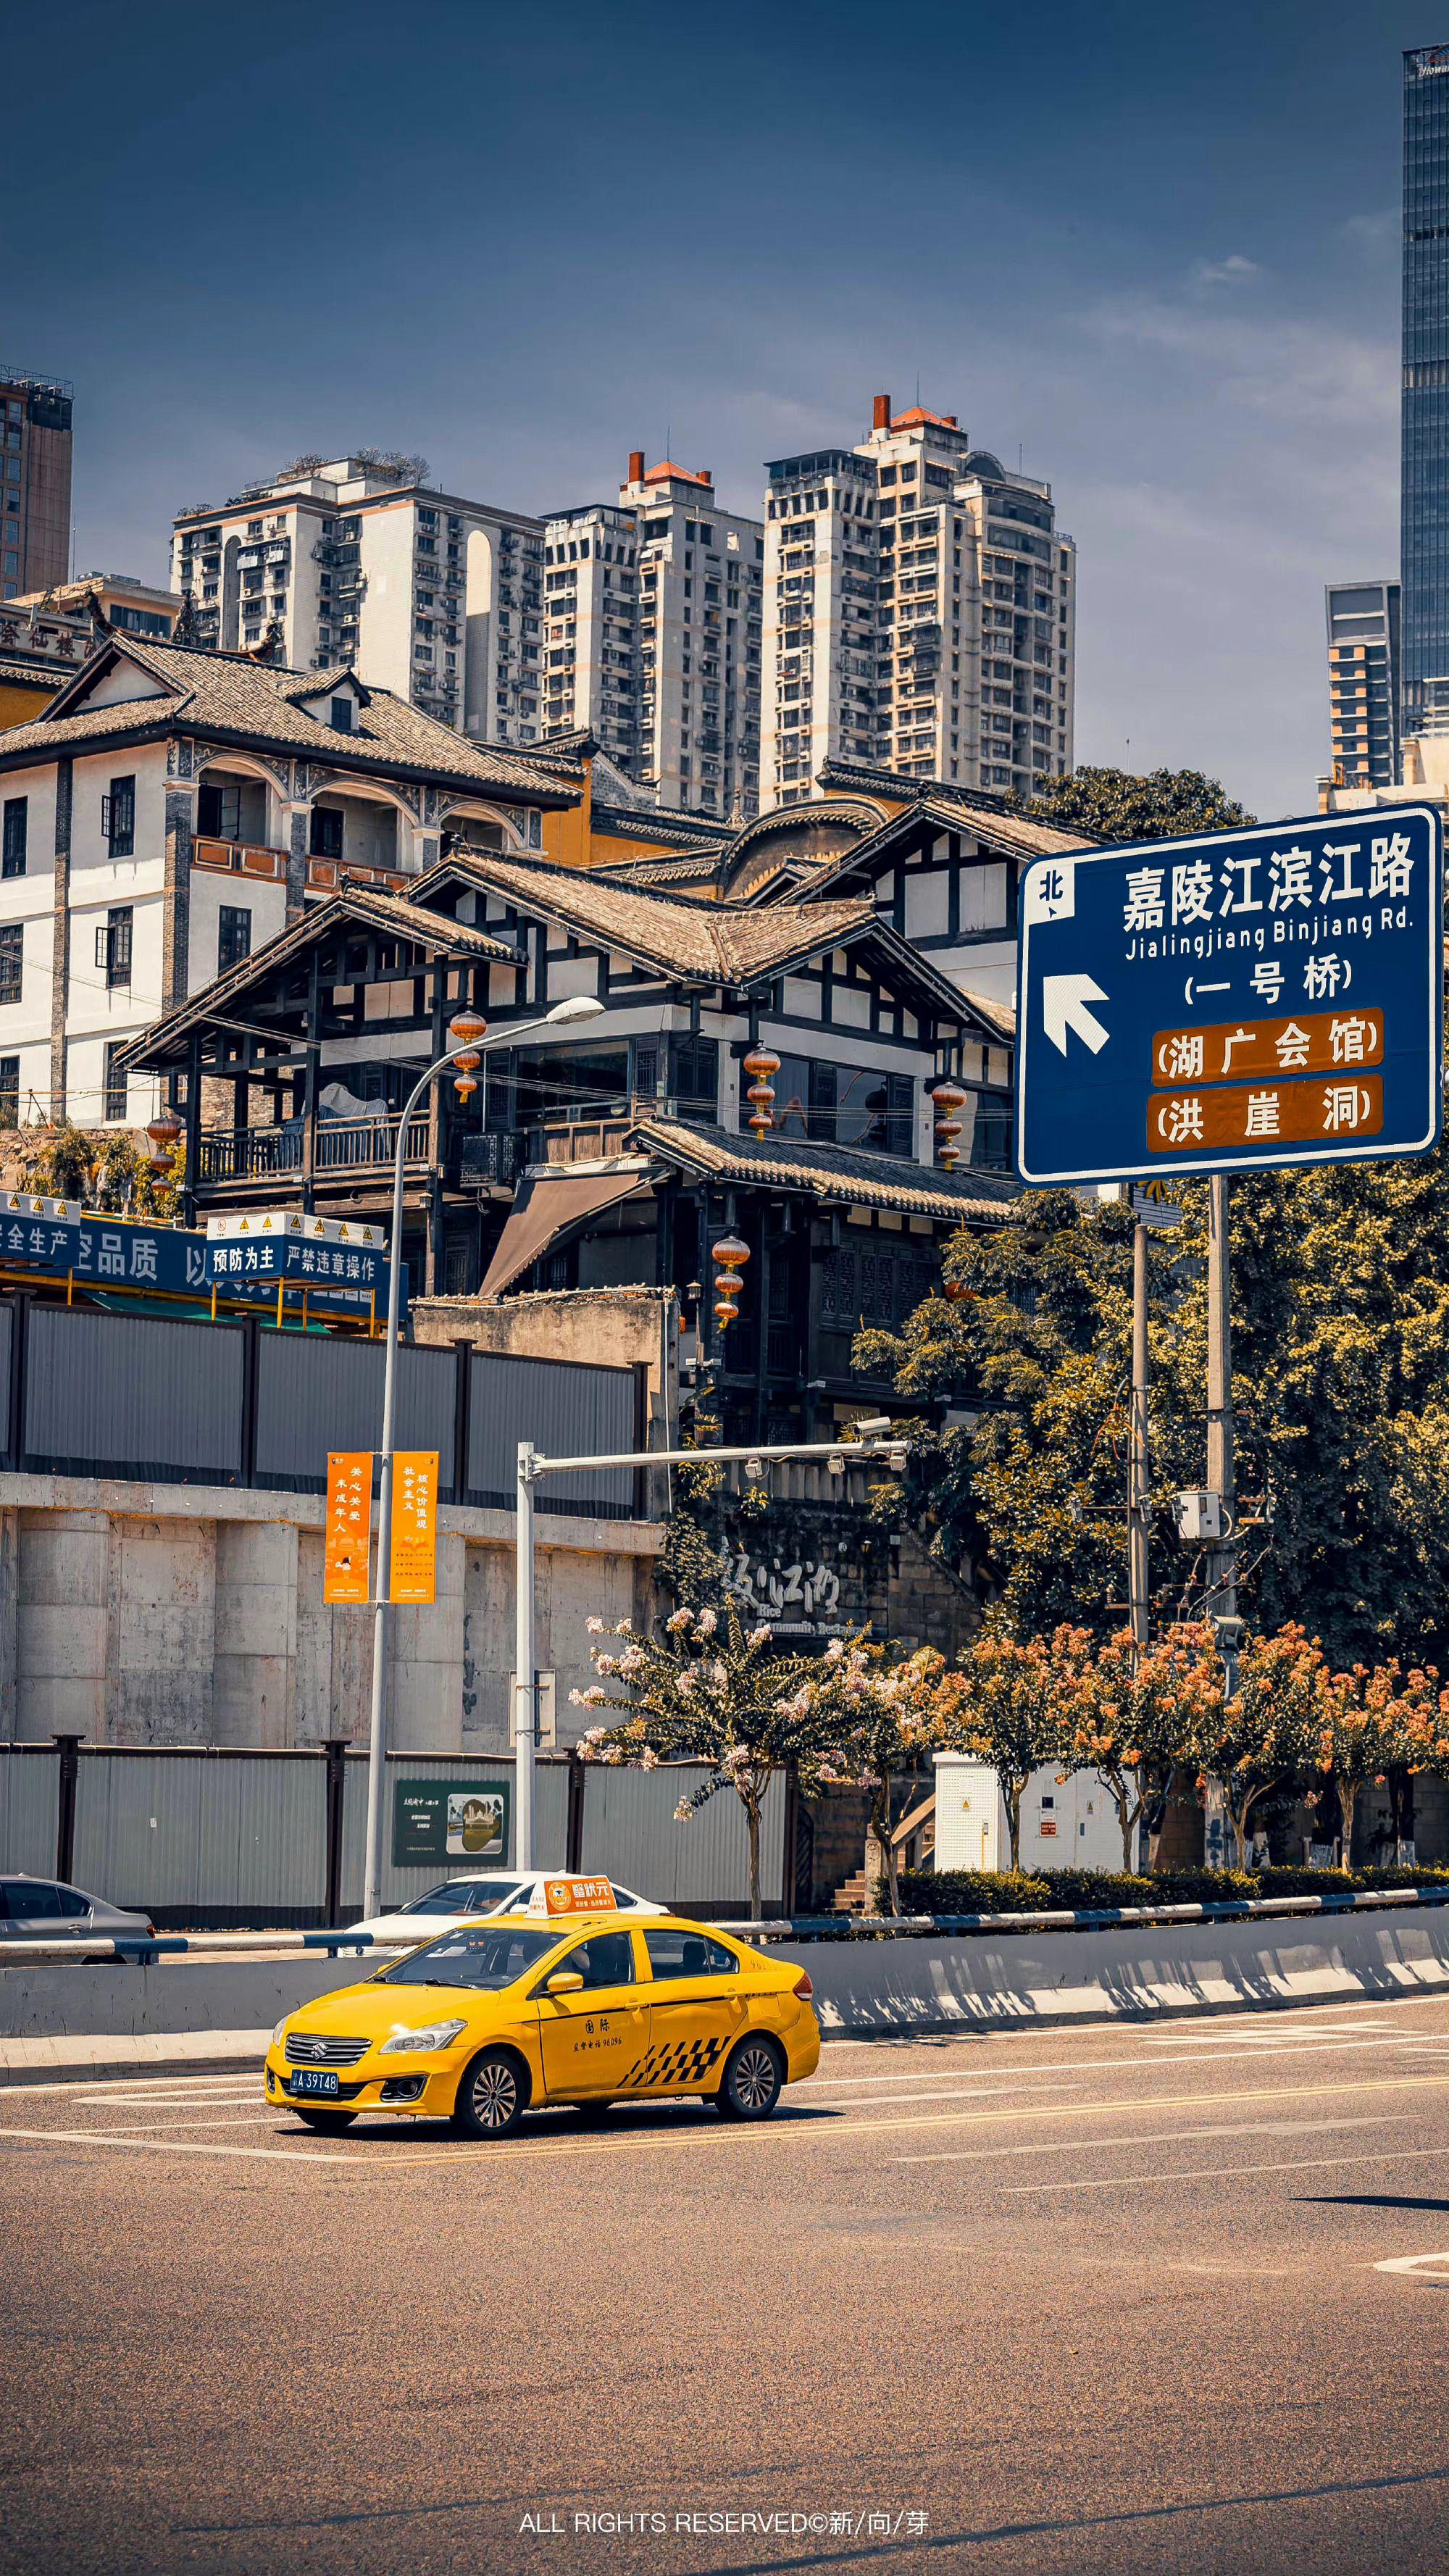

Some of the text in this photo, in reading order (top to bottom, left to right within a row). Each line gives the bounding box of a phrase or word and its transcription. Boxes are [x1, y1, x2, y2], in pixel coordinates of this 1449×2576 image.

[1039, 870, 1064, 902] 北
[1122, 833, 1415, 932] 嘉陵江滨江路
[1125, 906, 1413, 961] Jialingjiang Binjiang Rd.
[1185, 953, 1352, 1005] (一号桥)
[1158, 1016, 1378, 1079] (湖广会馆)
[1158, 1085, 1371, 1143] (洪崖洞)
[0, 1224, 68, 1256] 全生产
[213, 1246, 274, 1272] 预防为主
[287, 1246, 375, 1281] 严禁违章操作
[333, 1479, 348, 1533] 未成年人
[348, 1467, 363, 1521] 关心关爱
[403, 1467, 415, 1511] 社会主义
[416, 1475, 429, 1529] 核心价值观
[757, 1604, 782, 1617] Rice
[757, 1618, 816, 1636] Cmmunity
[585, 2018, 610, 2034] 国际
[603, 2036, 622, 2047] 96096
